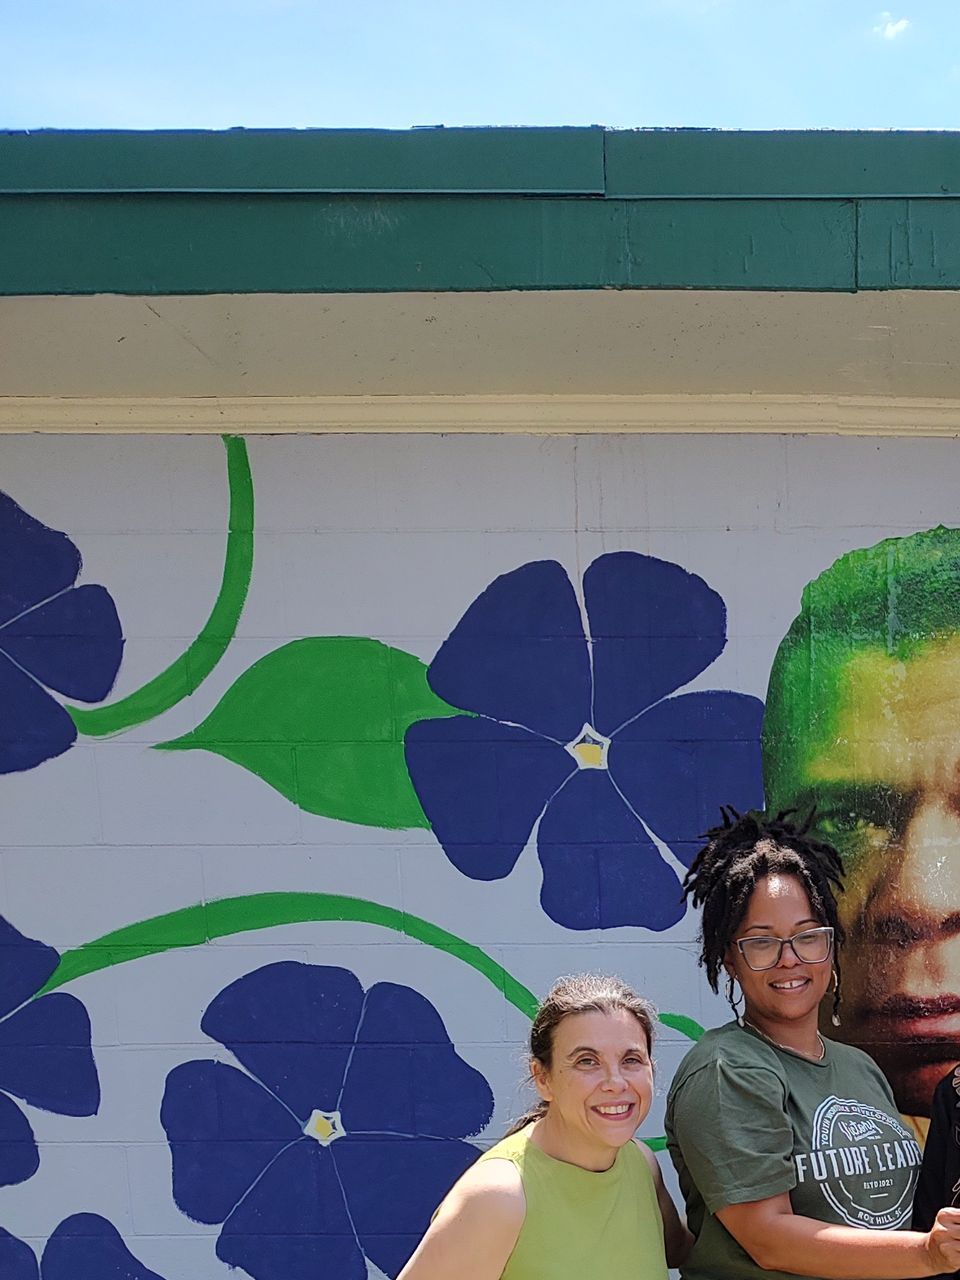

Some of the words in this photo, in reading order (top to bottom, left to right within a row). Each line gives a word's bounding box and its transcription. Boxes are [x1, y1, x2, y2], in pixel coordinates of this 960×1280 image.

[820, 1118, 832, 1146] YOUTH
[795, 1145, 872, 1183] FUTURE
[873, 1139, 924, 1172] LEADE
